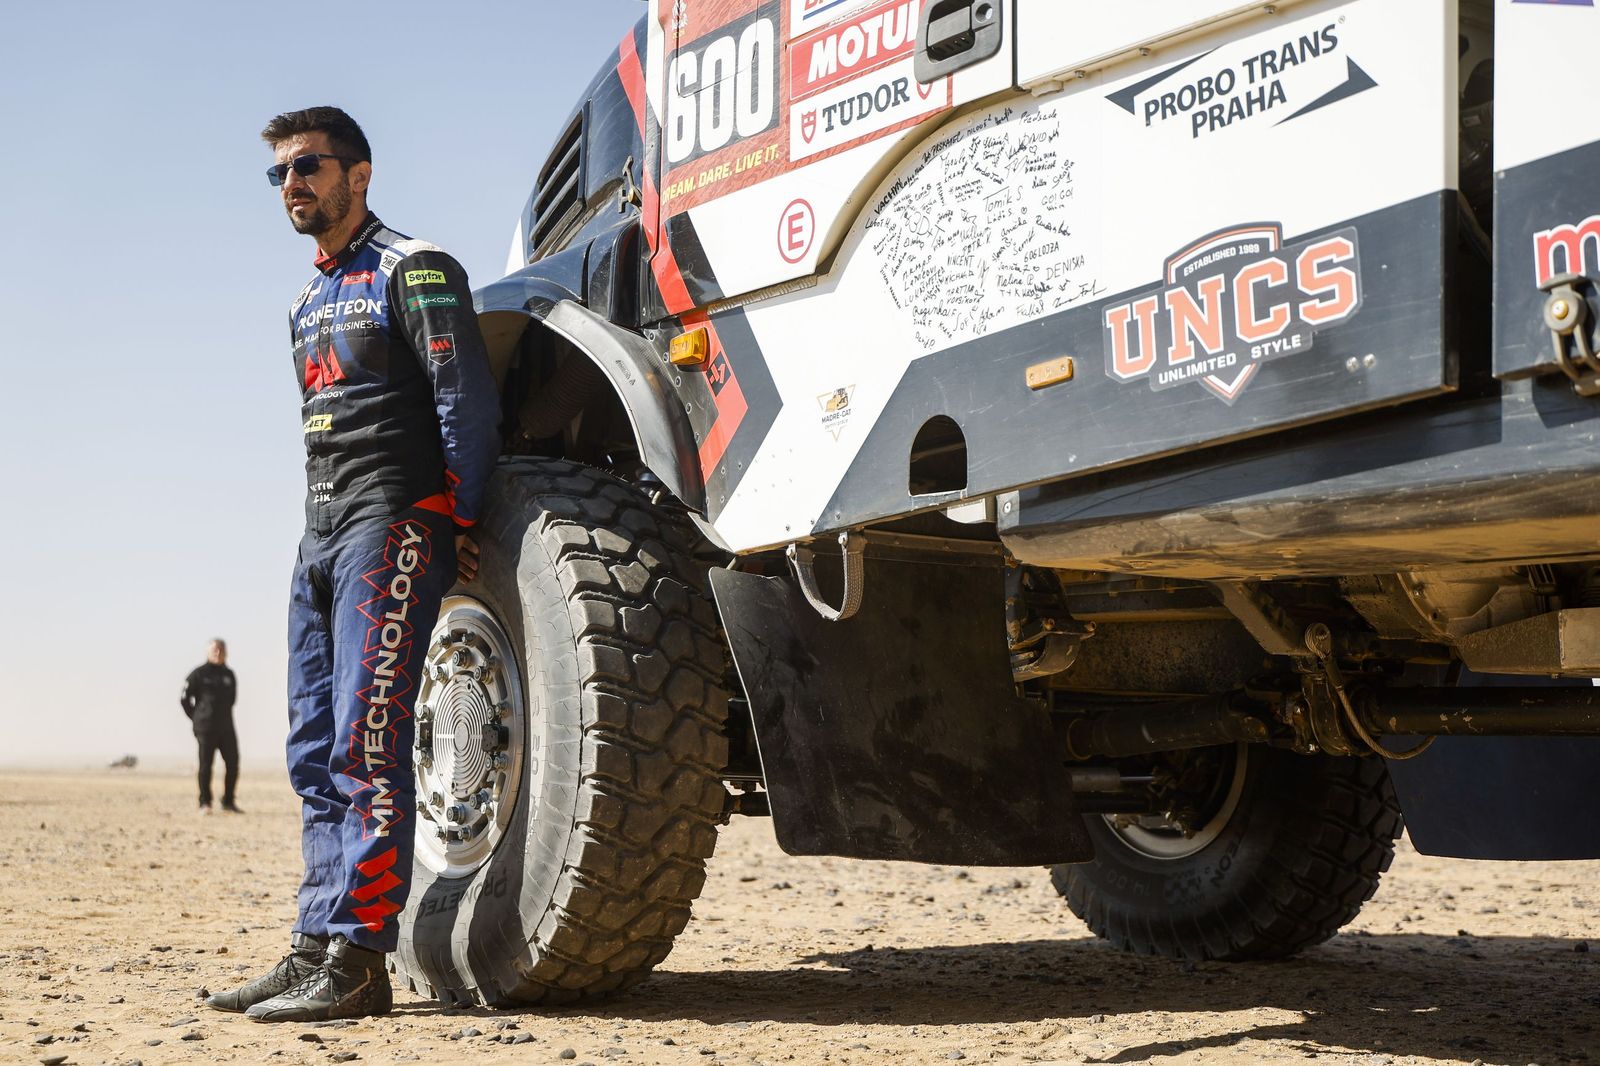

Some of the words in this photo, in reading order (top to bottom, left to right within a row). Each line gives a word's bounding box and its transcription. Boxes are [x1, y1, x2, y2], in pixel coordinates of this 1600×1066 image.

[667, 17, 775, 163] 600
[1144, 68, 1236, 127] PROBO
[1242, 24, 1339, 84] TRANS
[822, 76, 910, 133] TUDOR
[1191, 79, 1288, 139] PRAHA
[699, 162, 732, 188] DARE.
[735, 149, 763, 174] LIVE
[788, 211, 804, 251] E
[408, 272, 442, 282] Seyfor
[1183, 246, 1237, 277] ESTABLISHED
[335, 320, 380, 333] BUSINESS
[1105, 236, 1358, 379] UNCS
[1158, 352, 1236, 385] UNLIMITED
[1250, 334, 1302, 360] STYLE
[364, 523, 423, 773] TECHNOLOGY
